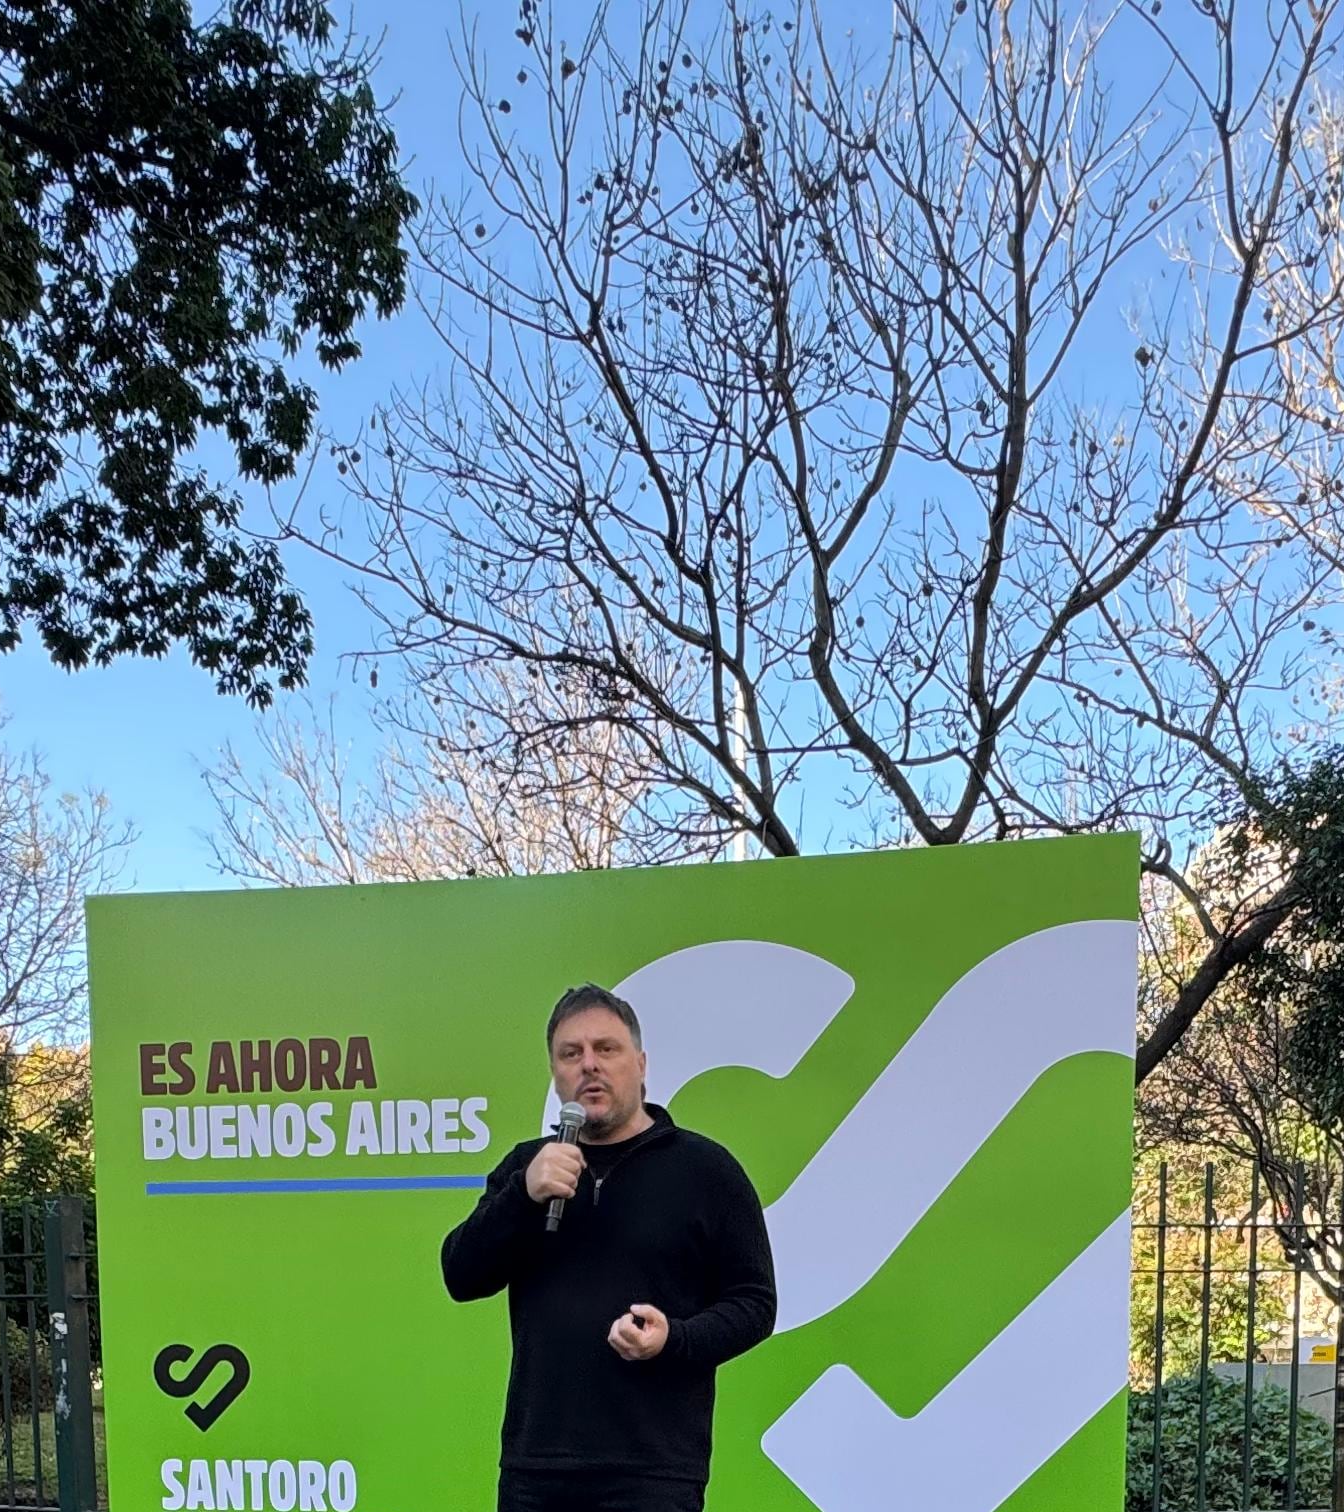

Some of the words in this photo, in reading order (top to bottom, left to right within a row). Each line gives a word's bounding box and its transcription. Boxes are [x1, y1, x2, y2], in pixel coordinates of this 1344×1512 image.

[139, 1041, 196, 1096] ES
[205, 1036, 378, 1095] AHORA
[142, 1101, 337, 1161] BUENOS
[345, 1096, 491, 1156] AIRES
[160, 1458, 358, 1512] SANTORO
